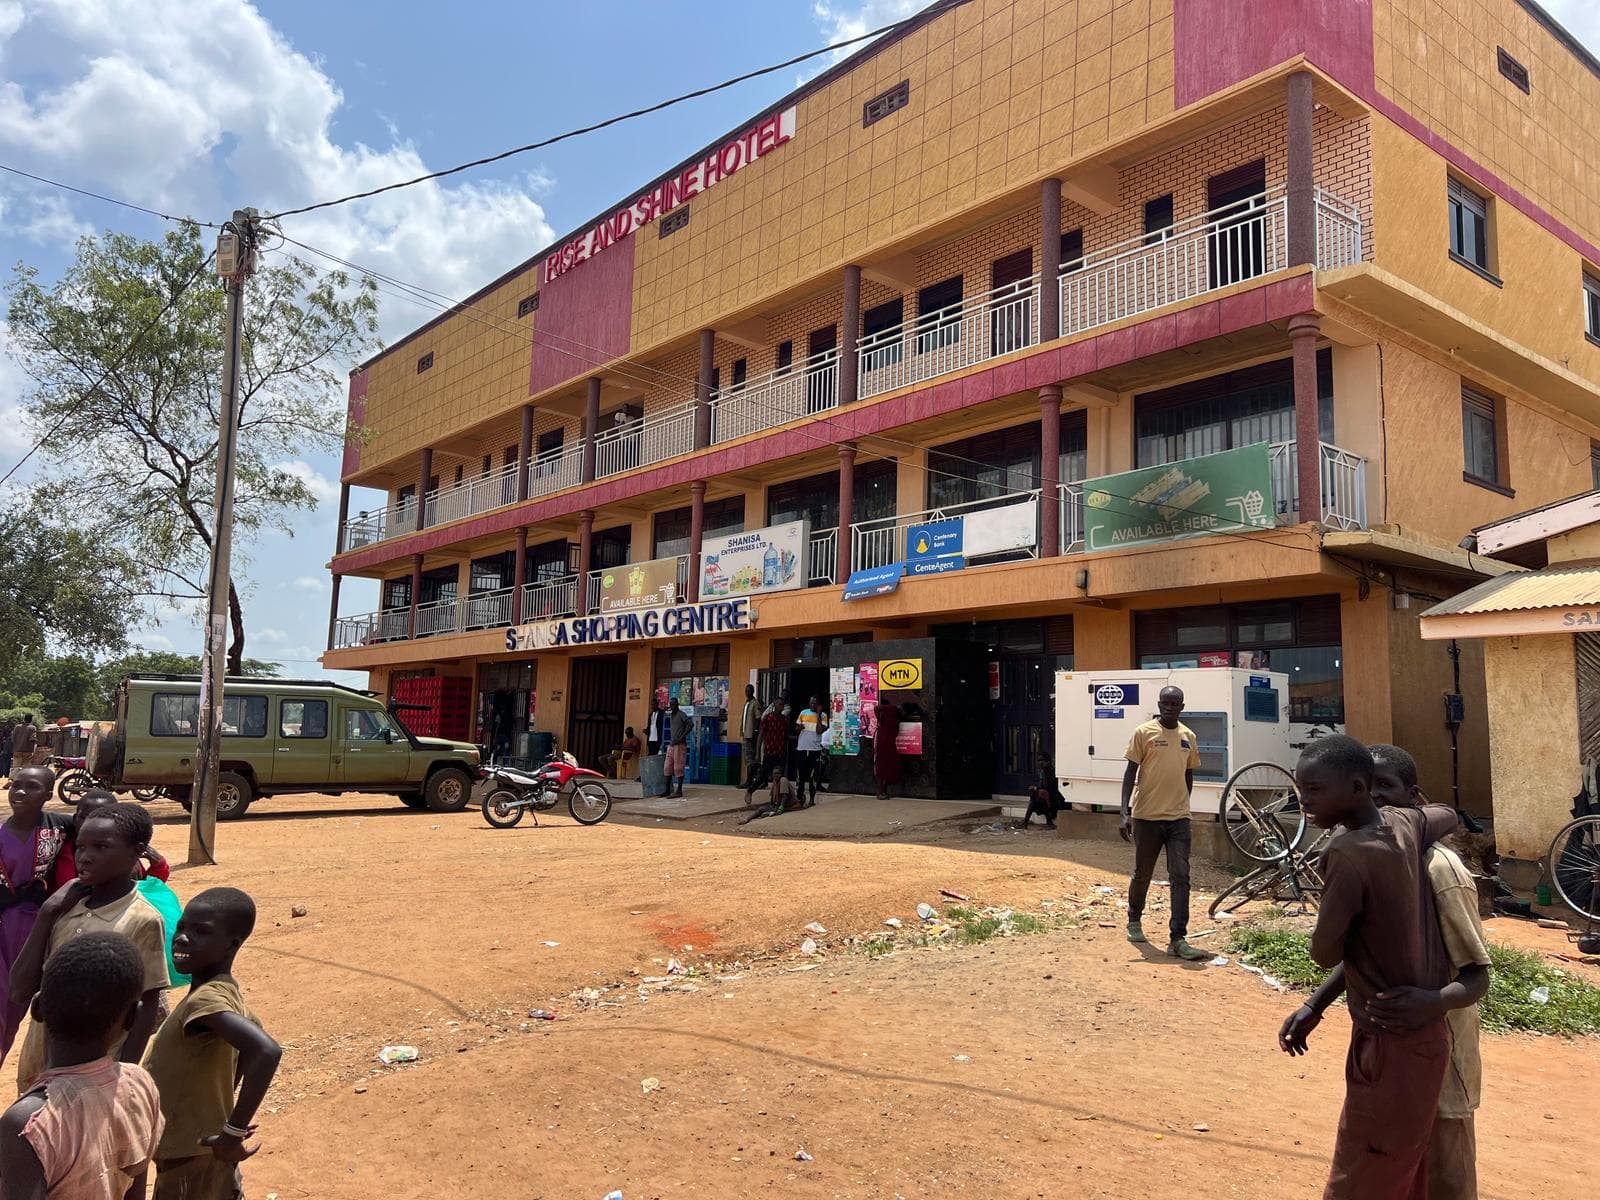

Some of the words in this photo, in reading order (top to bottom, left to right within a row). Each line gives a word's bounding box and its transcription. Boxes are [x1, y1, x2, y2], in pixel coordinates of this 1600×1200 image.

[546, 236, 585, 281] RISE
[589, 207, 632, 255] AND
[636, 166, 698, 225] SHINE
[704, 113, 789, 188] HOTEL
[1111, 520, 1181, 543] AVAILABLE
[1183, 514, 1218, 530] HERE
[728, 534, 761, 548] SHANISA
[720, 543, 756, 556] ENTERPRISES
[914, 560, 954, 573] CenteAgent
[609, 597, 641, 609] AVAILABLE
[641, 594, 659, 605] HERE
[662, 600, 748, 635] CENTRE
[890, 670, 909, 680] MTN
